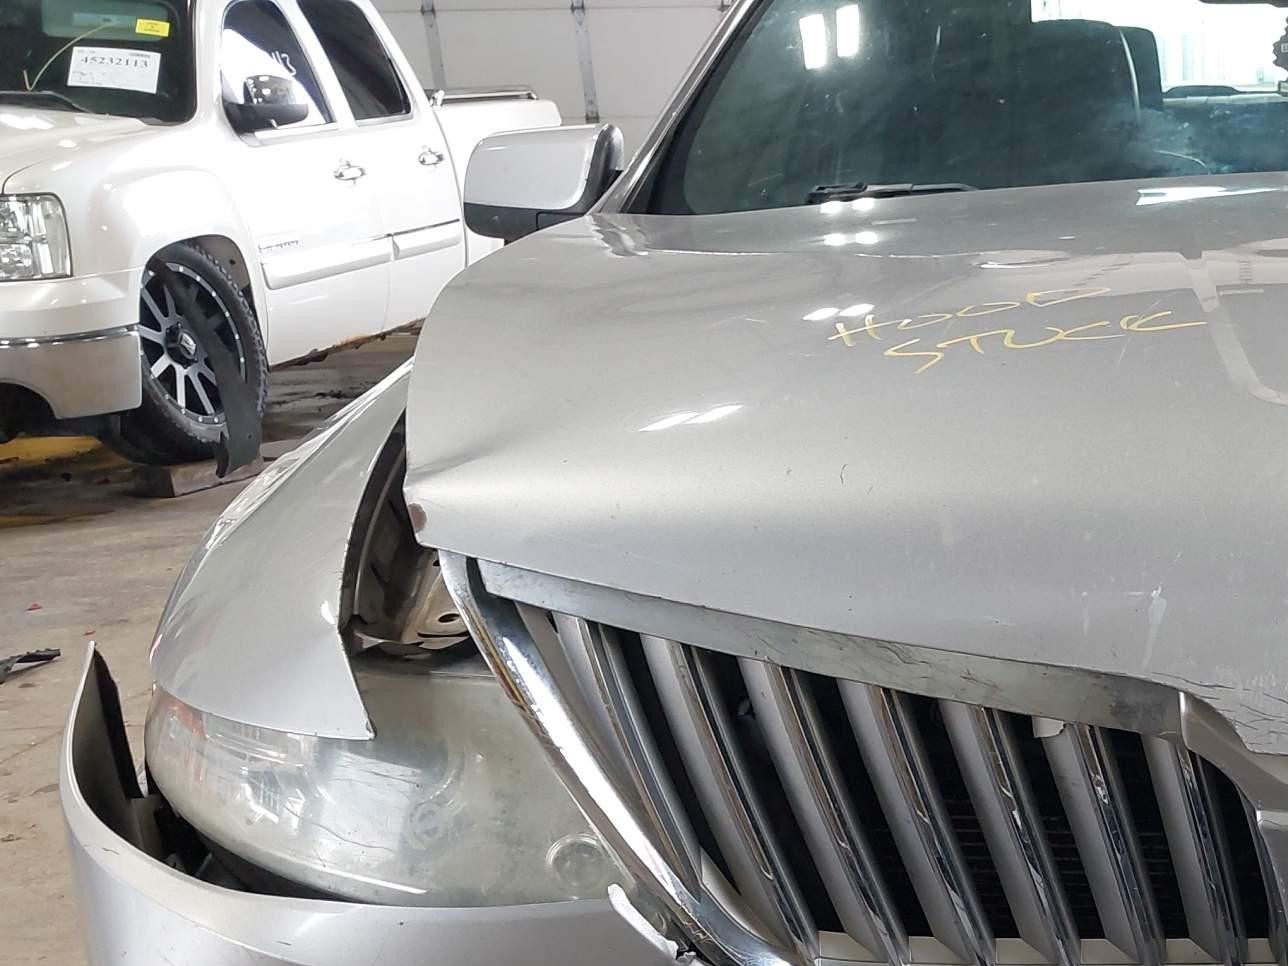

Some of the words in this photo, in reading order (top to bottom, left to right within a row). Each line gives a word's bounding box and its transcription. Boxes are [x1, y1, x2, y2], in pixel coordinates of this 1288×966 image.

[80, 56, 149, 68] 45232113
[828, 287, 1111, 347] HOOD
[884, 310, 1208, 374] STUCK
